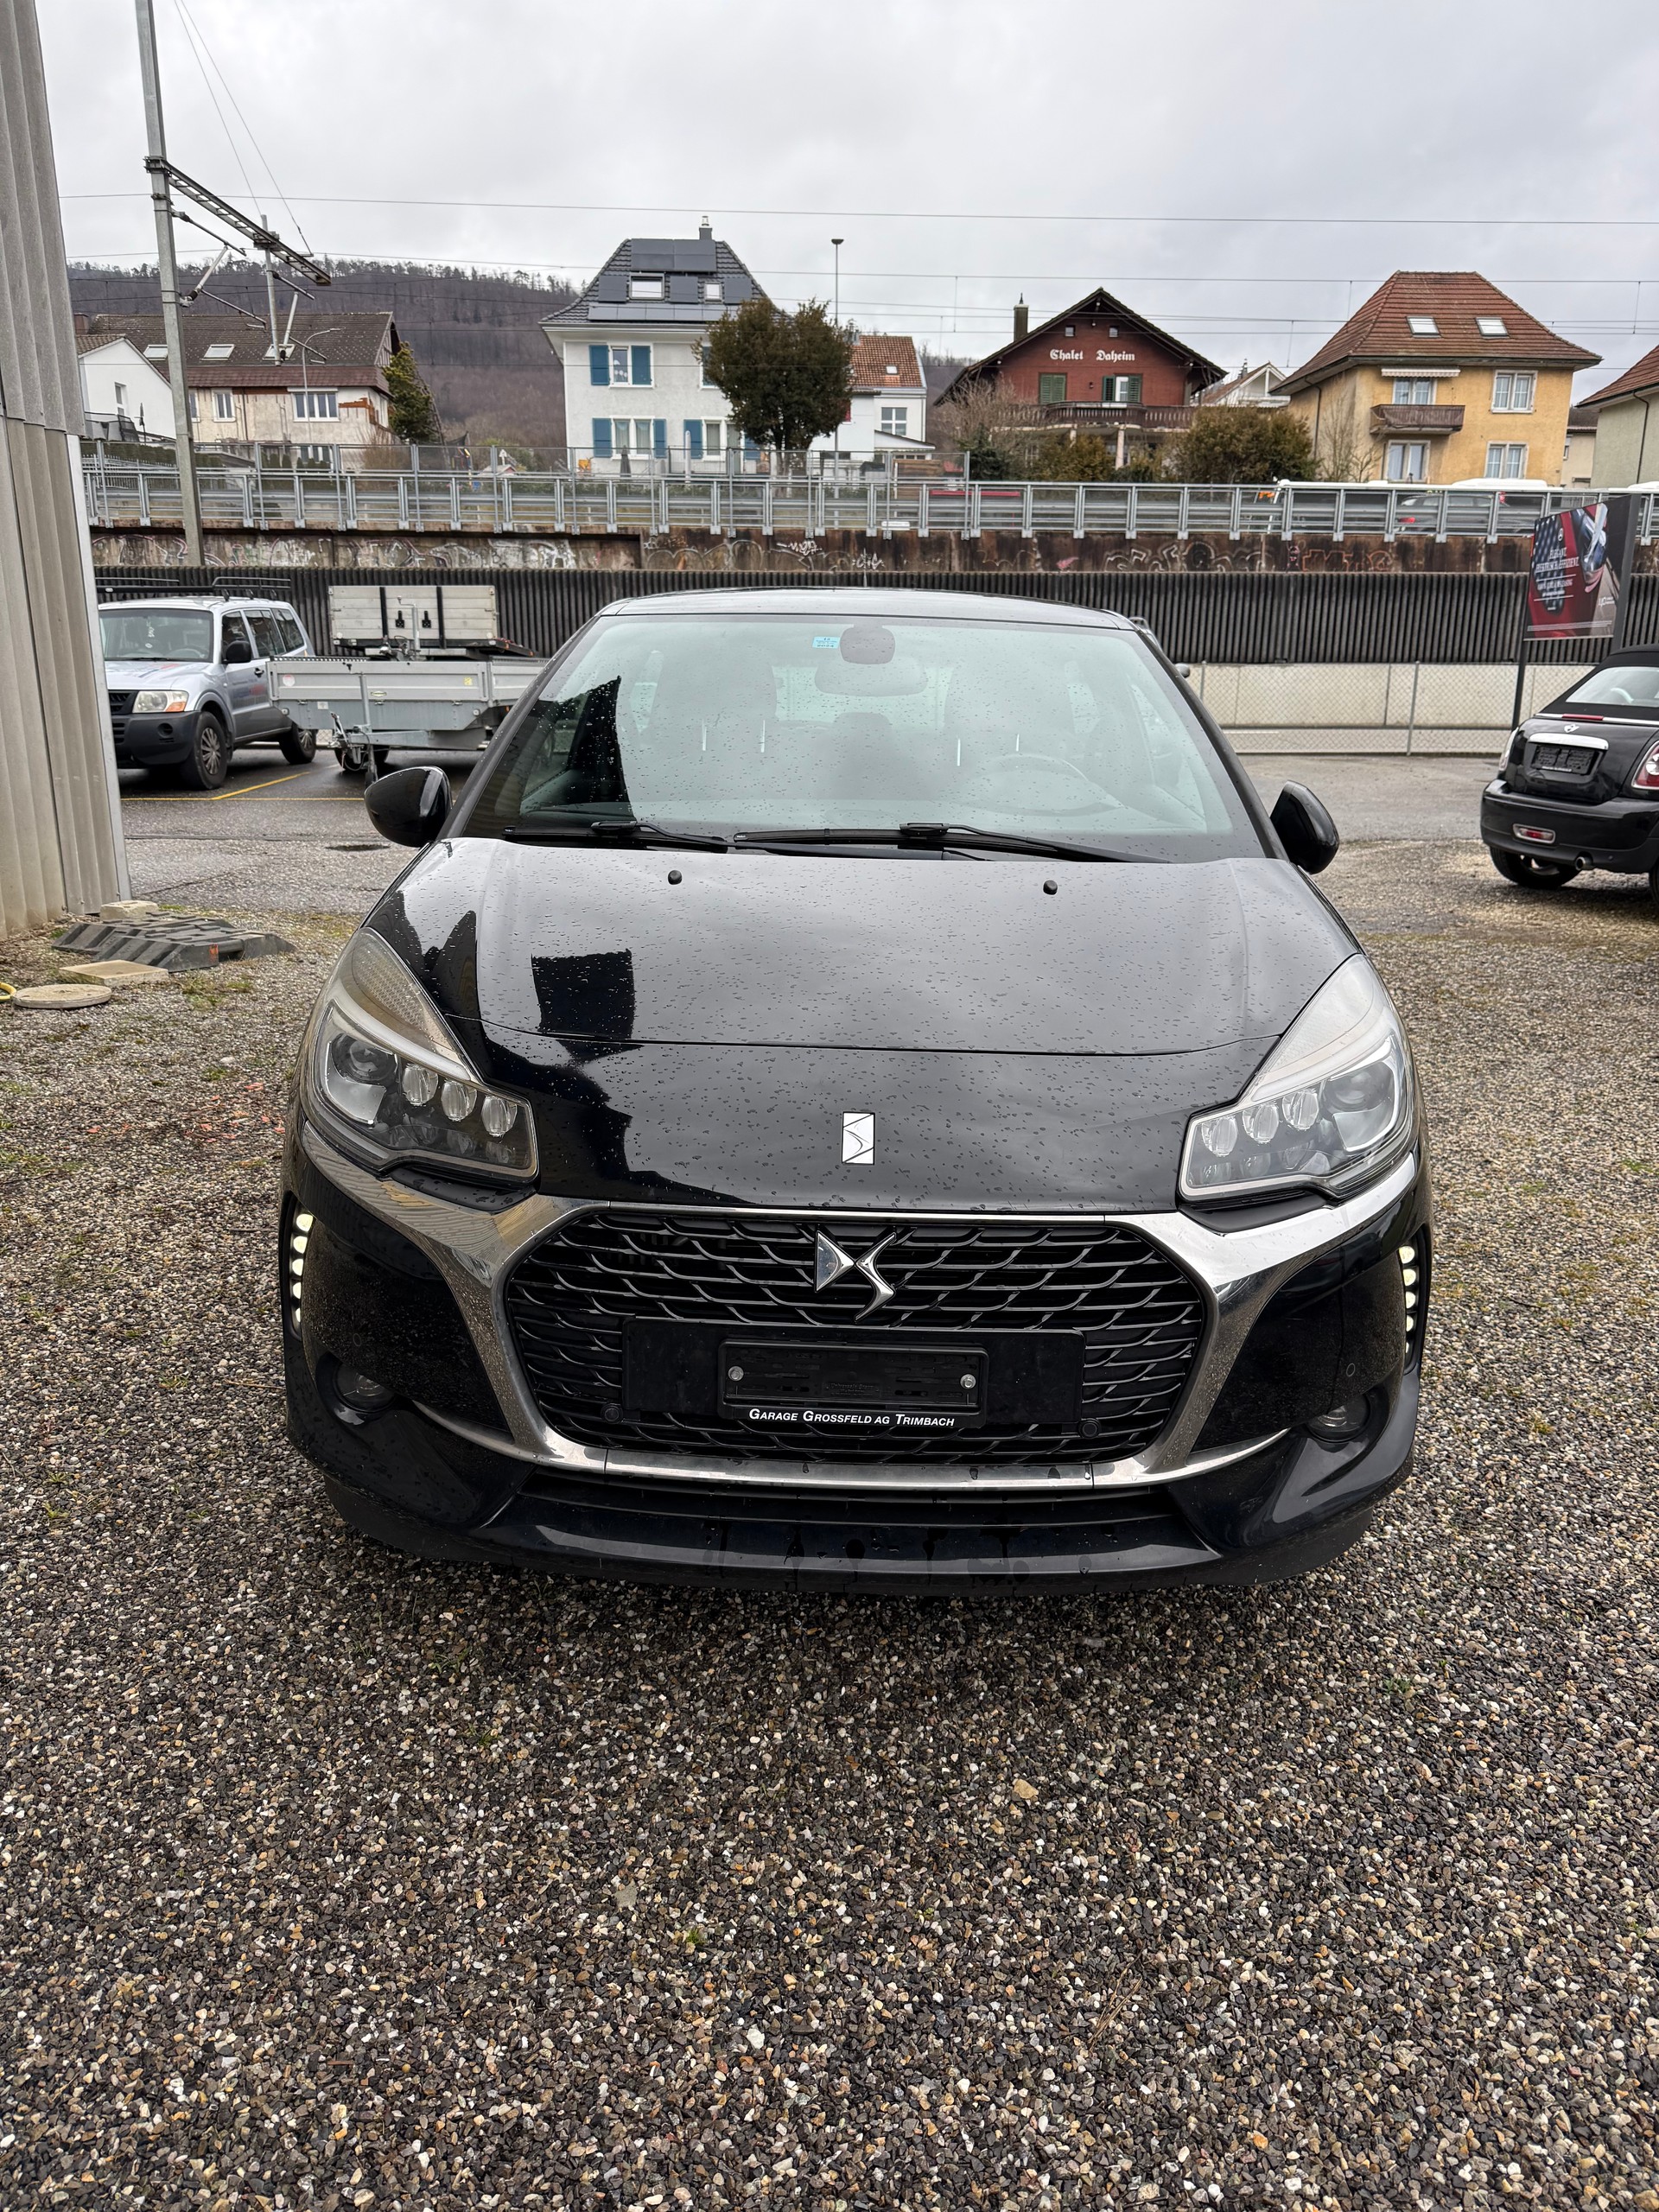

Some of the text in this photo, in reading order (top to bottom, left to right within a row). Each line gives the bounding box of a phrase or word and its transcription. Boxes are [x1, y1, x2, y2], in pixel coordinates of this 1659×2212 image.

[1050, 349, 1135, 363] Chalet Daheim
[749, 1408, 798, 1421] GARAGE
[804, 1411, 872, 1423] GROSSFELD
[896, 1414, 954, 1426] TRIMBACH
